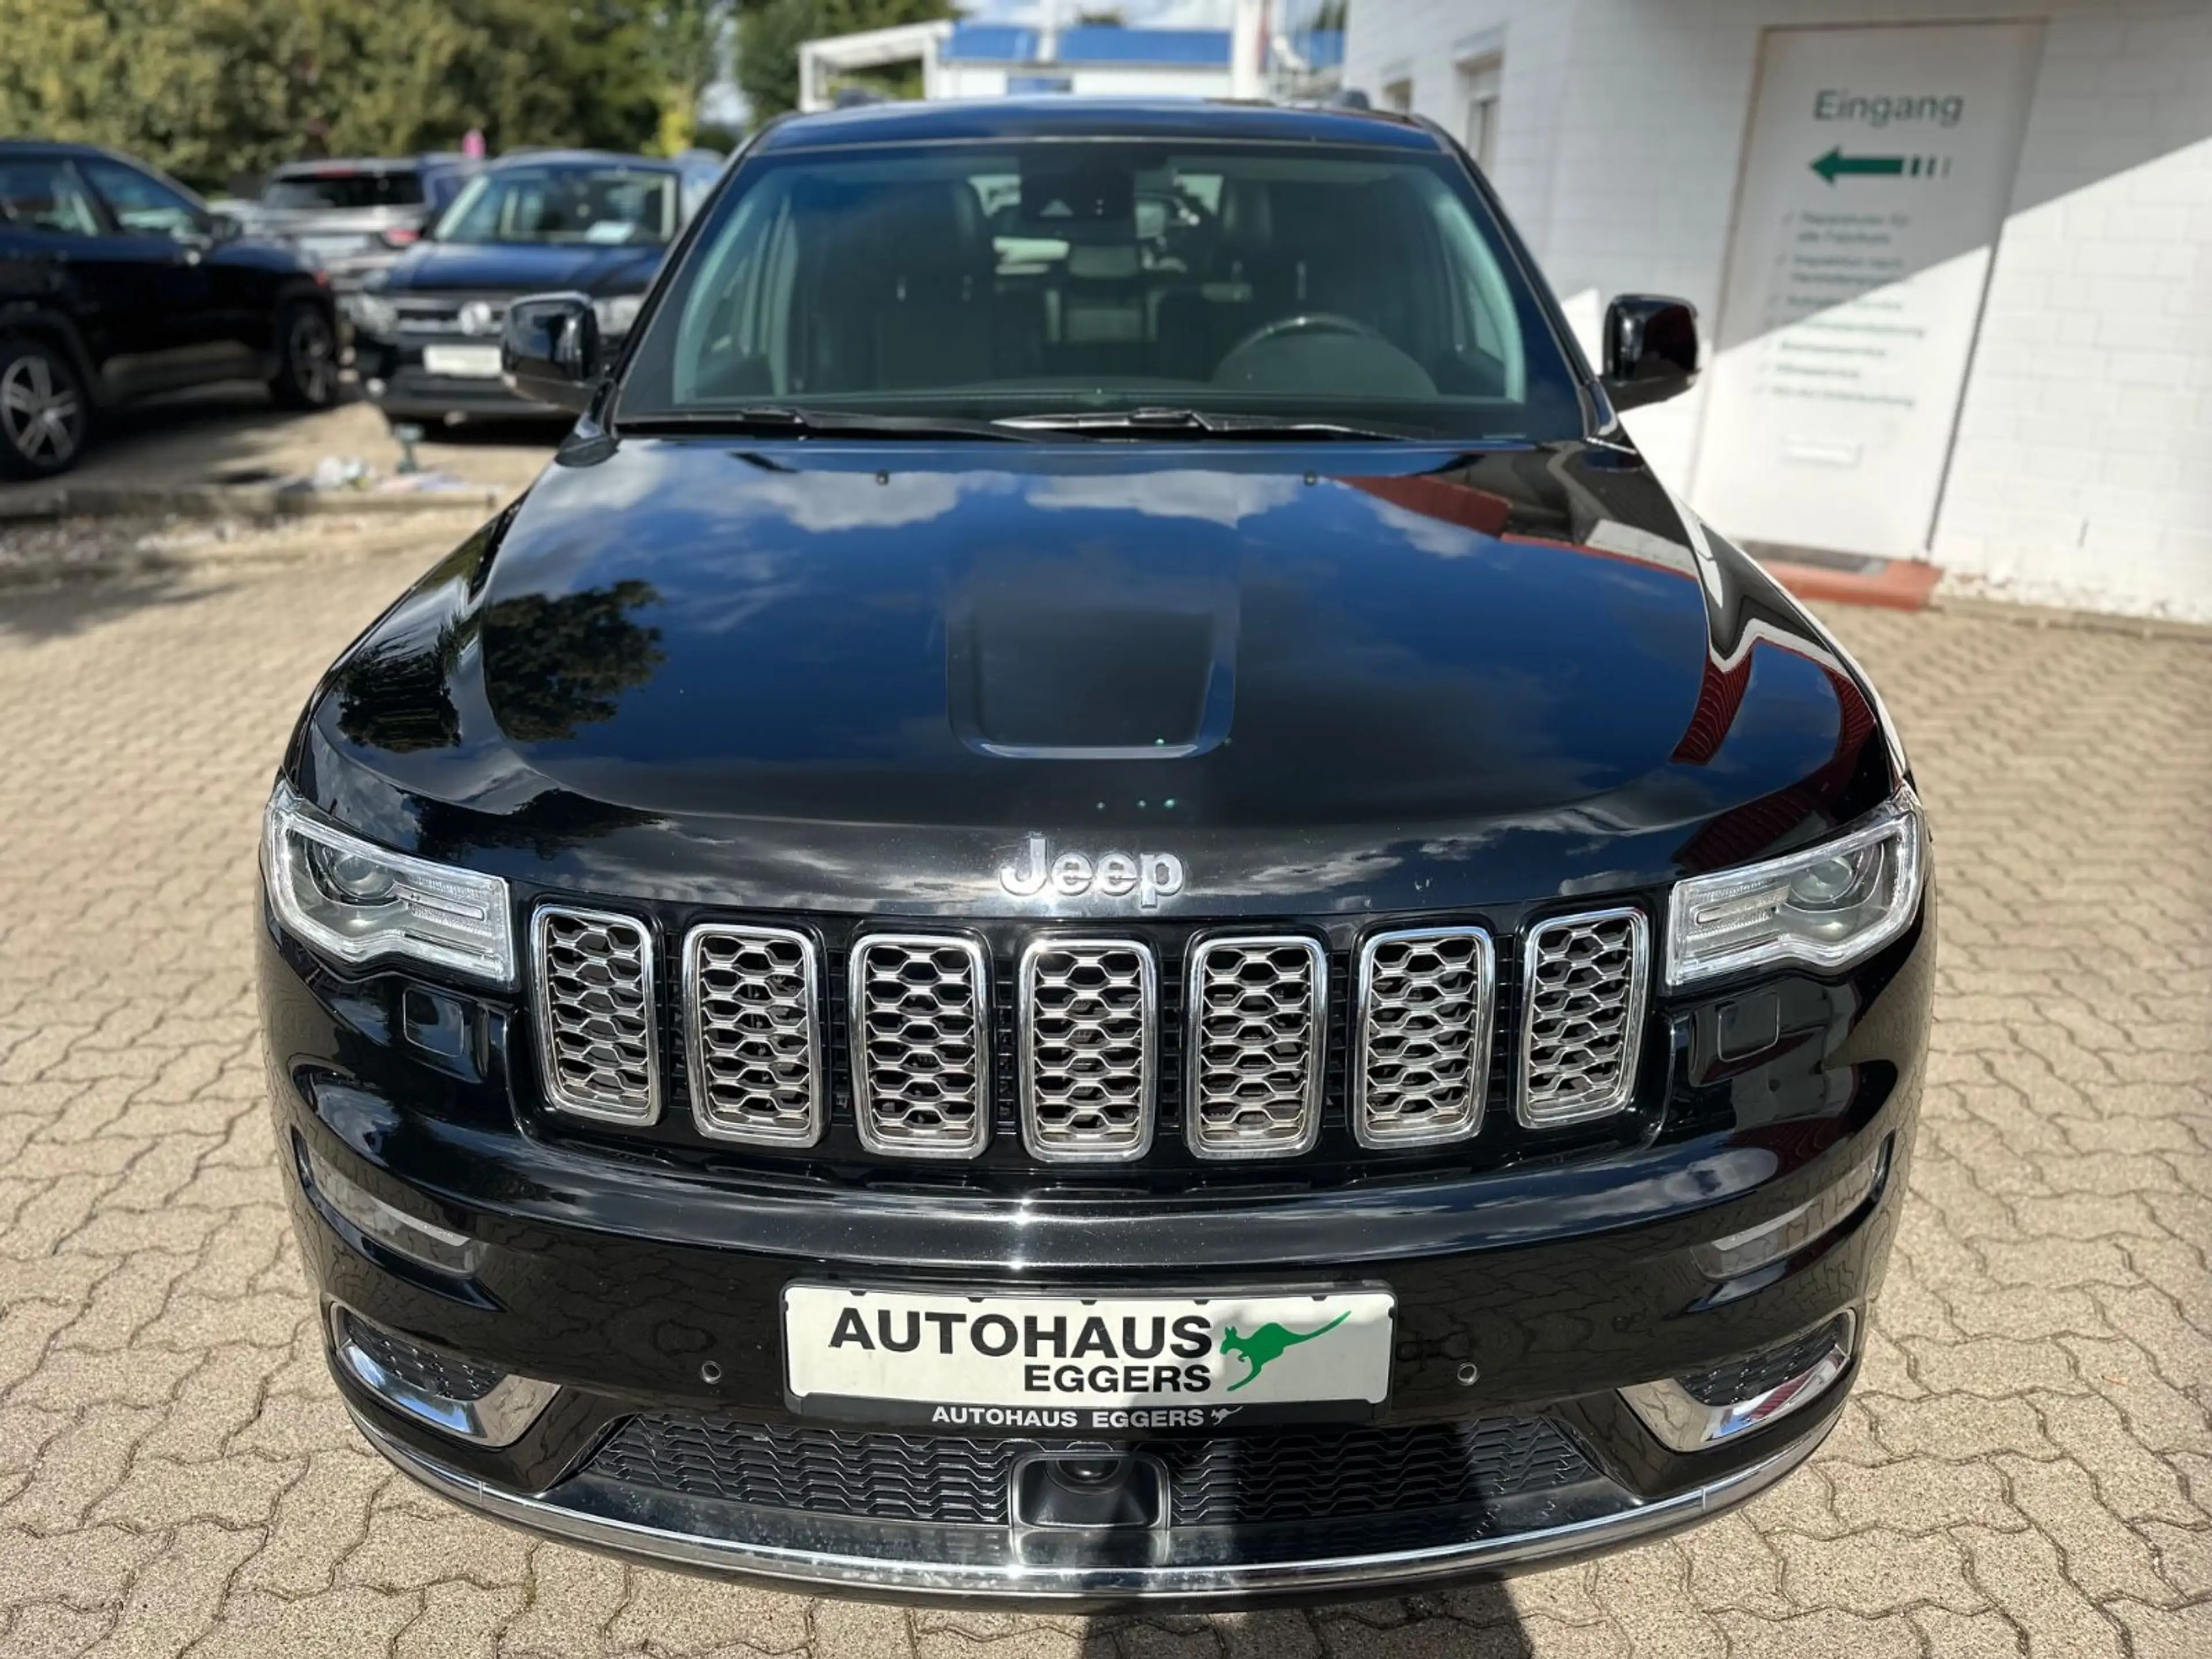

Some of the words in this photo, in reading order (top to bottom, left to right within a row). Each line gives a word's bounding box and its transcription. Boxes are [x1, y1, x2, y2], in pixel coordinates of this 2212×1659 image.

[1813, 89, 1964, 127] Eingang
[999, 837, 1183, 908] Jeep
[828, 1307, 1212, 1358] AUTOHAUS
[1024, 1364, 1211, 1392] EGGERS
[931, 1406, 1078, 1427] AUTOHAUS
[1092, 1409, 1204, 1428] EGGERS
